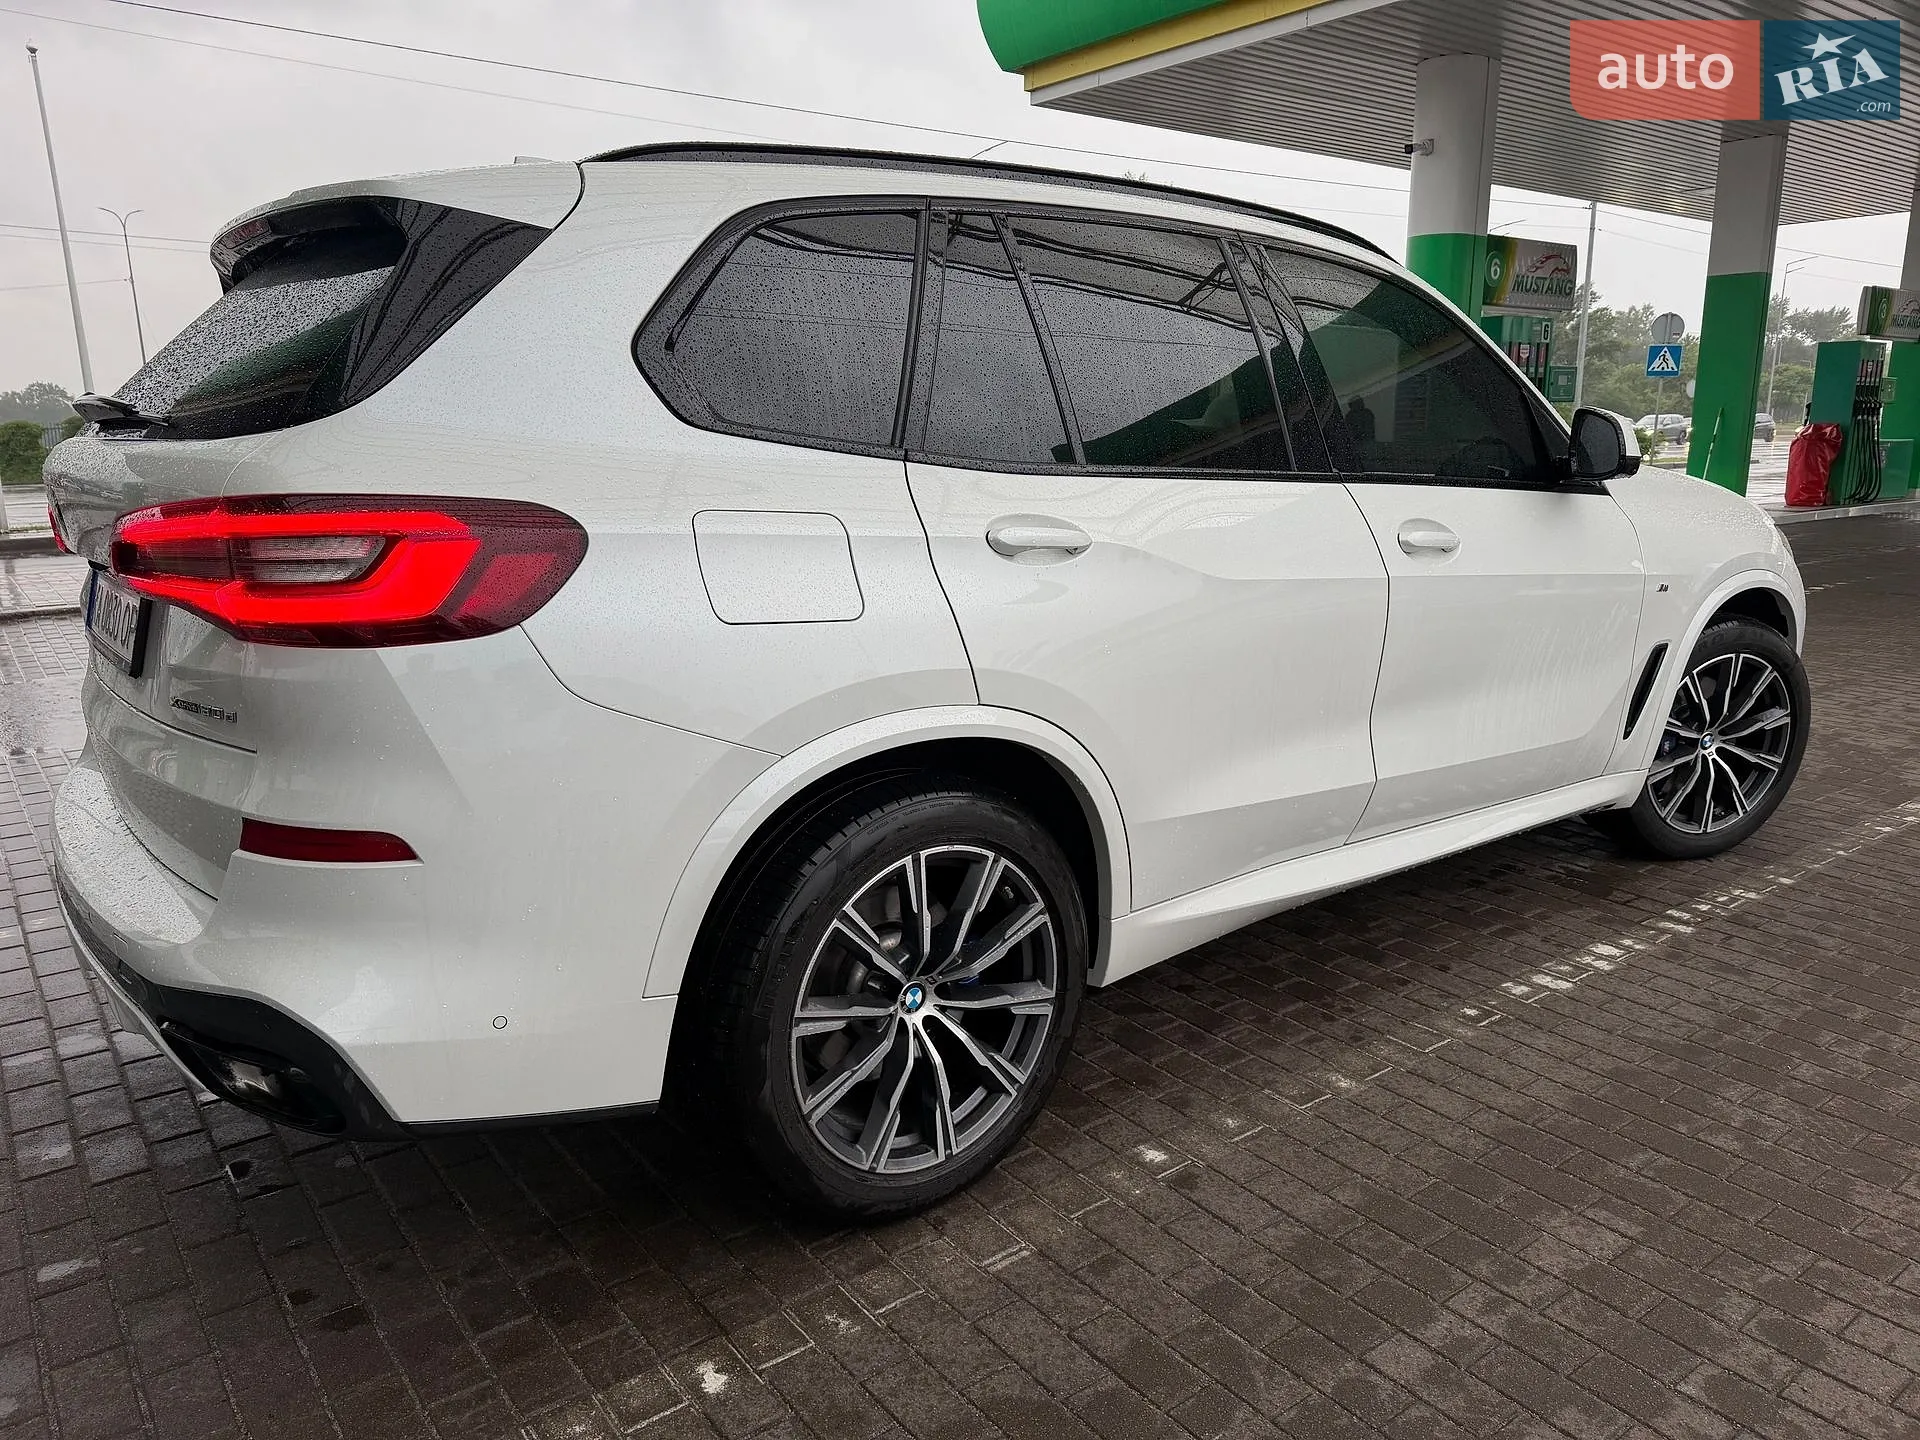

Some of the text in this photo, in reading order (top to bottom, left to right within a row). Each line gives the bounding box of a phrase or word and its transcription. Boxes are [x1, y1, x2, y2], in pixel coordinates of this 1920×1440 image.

[1491, 259, 1501, 280] 6
[1512, 274, 1573, 296] MUSTANG
[1543, 323, 1550, 341] 6
